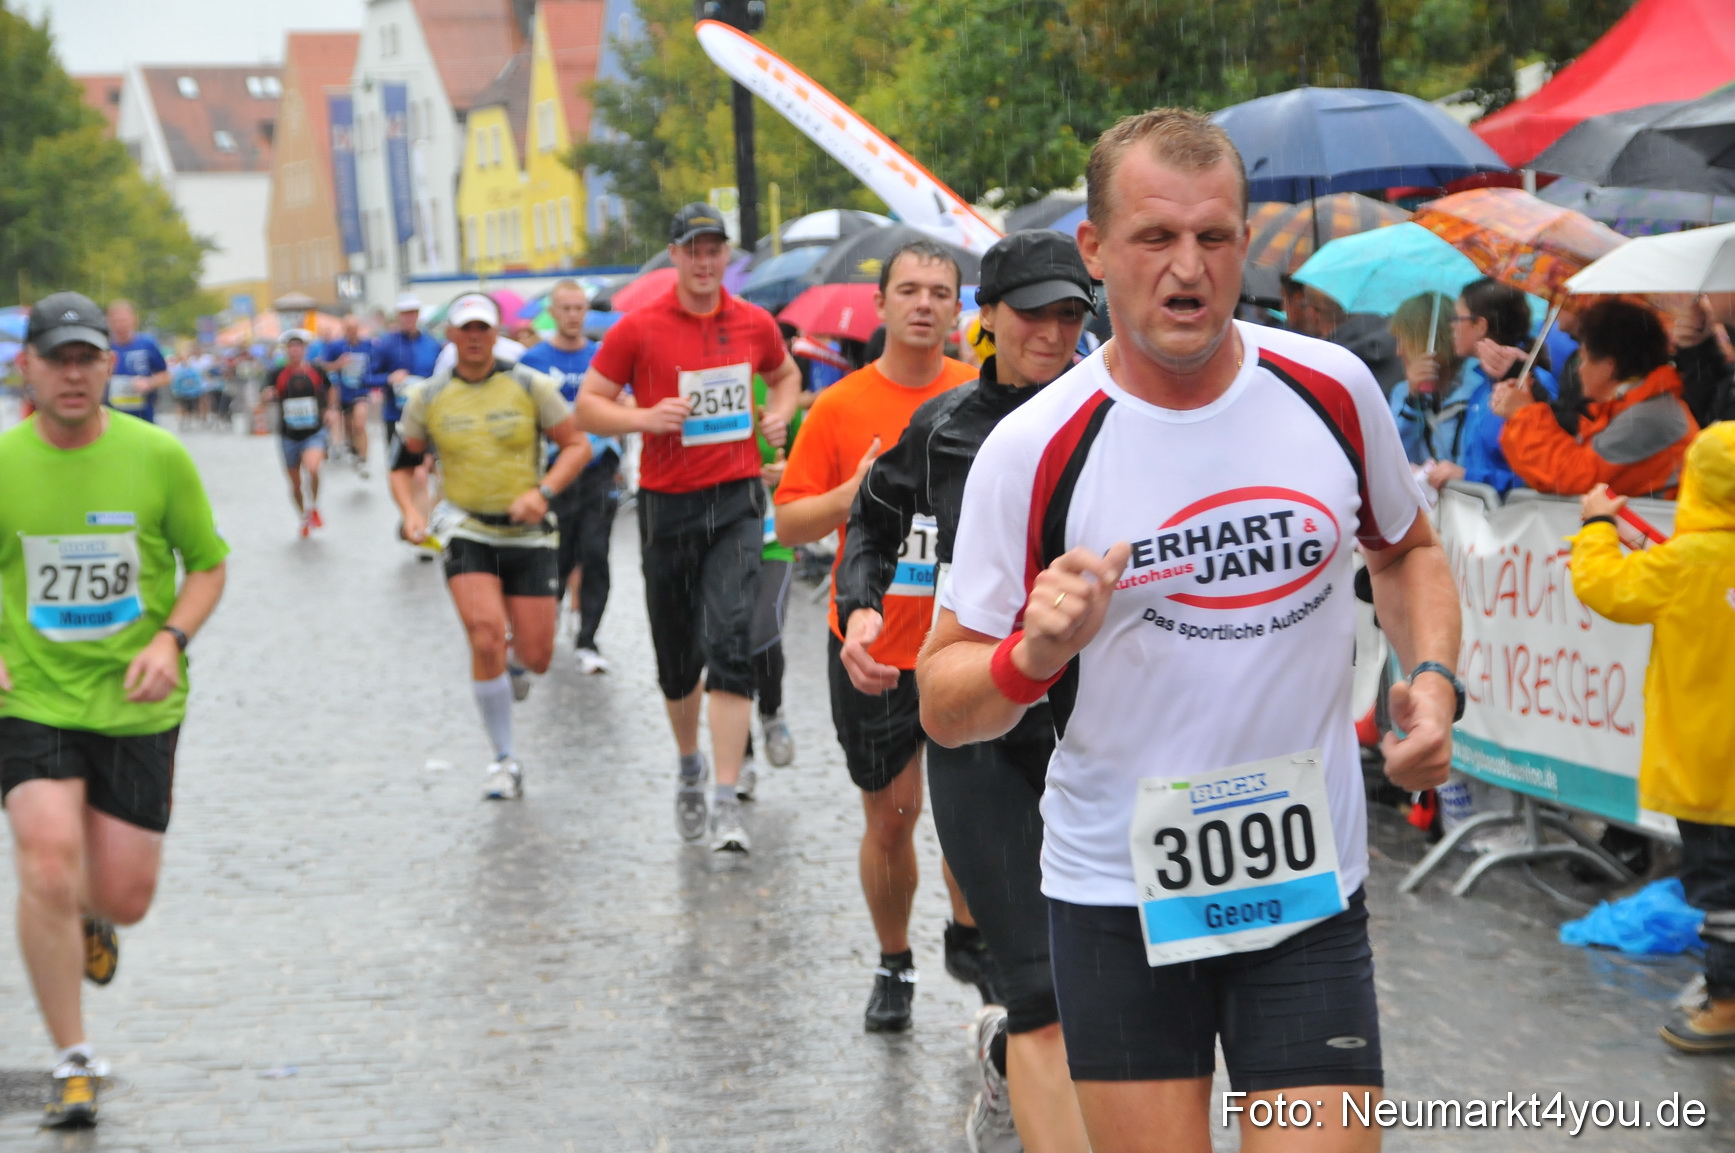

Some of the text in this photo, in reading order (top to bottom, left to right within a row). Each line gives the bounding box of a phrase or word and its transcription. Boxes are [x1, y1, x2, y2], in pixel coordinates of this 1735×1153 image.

[689, 385, 746, 416] 2542
[1103, 510, 1318, 569] ERHART &
[1195, 539, 1322, 584] JÄNIG
[39, 562, 130, 601] 2758
[1142, 608, 1175, 632] Das
[1178, 621, 1265, 641] sportliche
[1154, 804, 1316, 890] 3090
[1205, 899, 1283, 928] Georg
